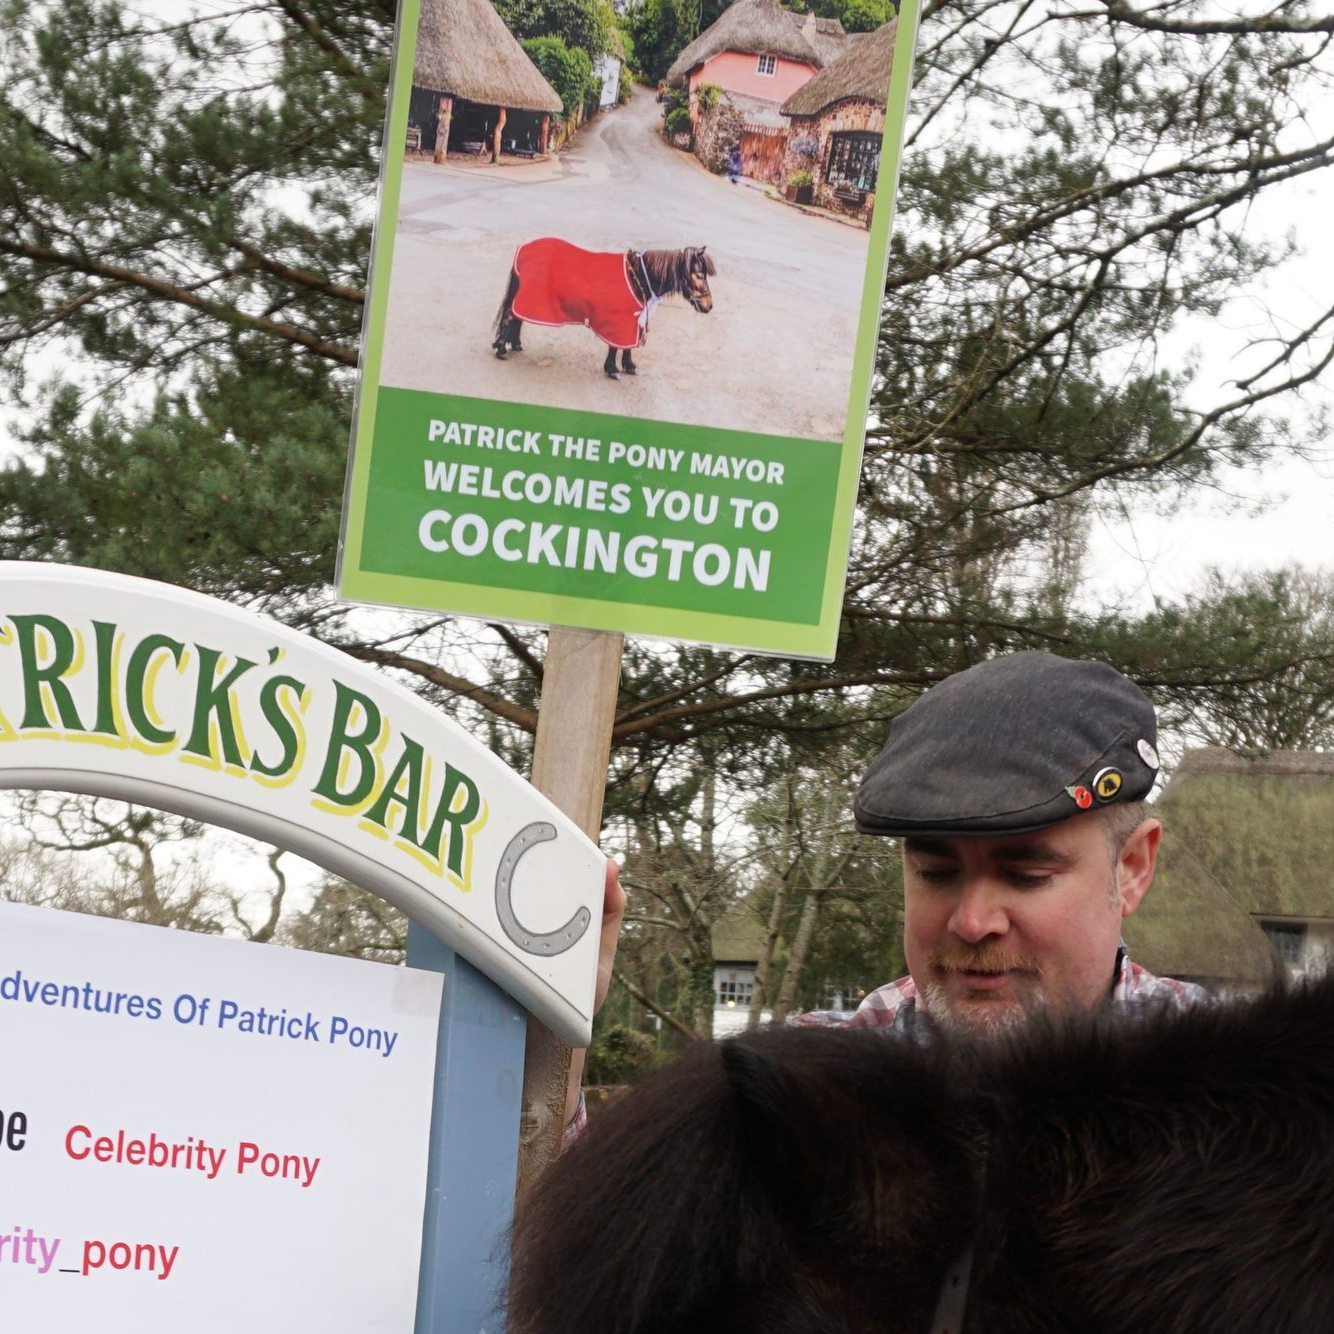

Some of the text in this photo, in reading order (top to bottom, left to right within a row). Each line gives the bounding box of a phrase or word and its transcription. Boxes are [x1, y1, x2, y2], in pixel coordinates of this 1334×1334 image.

[428, 418, 785, 485] PATRICK THE PONY MAYOR
[423, 459, 780, 533] WELCOMES YOU TO
[418, 509, 772, 593] COCKINGTON
[312, 678, 487, 886] BAR
[172, 992, 211, 1027] Of
[216, 998, 321, 1043] Patrick
[328, 1015, 399, 1058] Pony
[64, 1124, 321, 1188] Celebrity Pony
